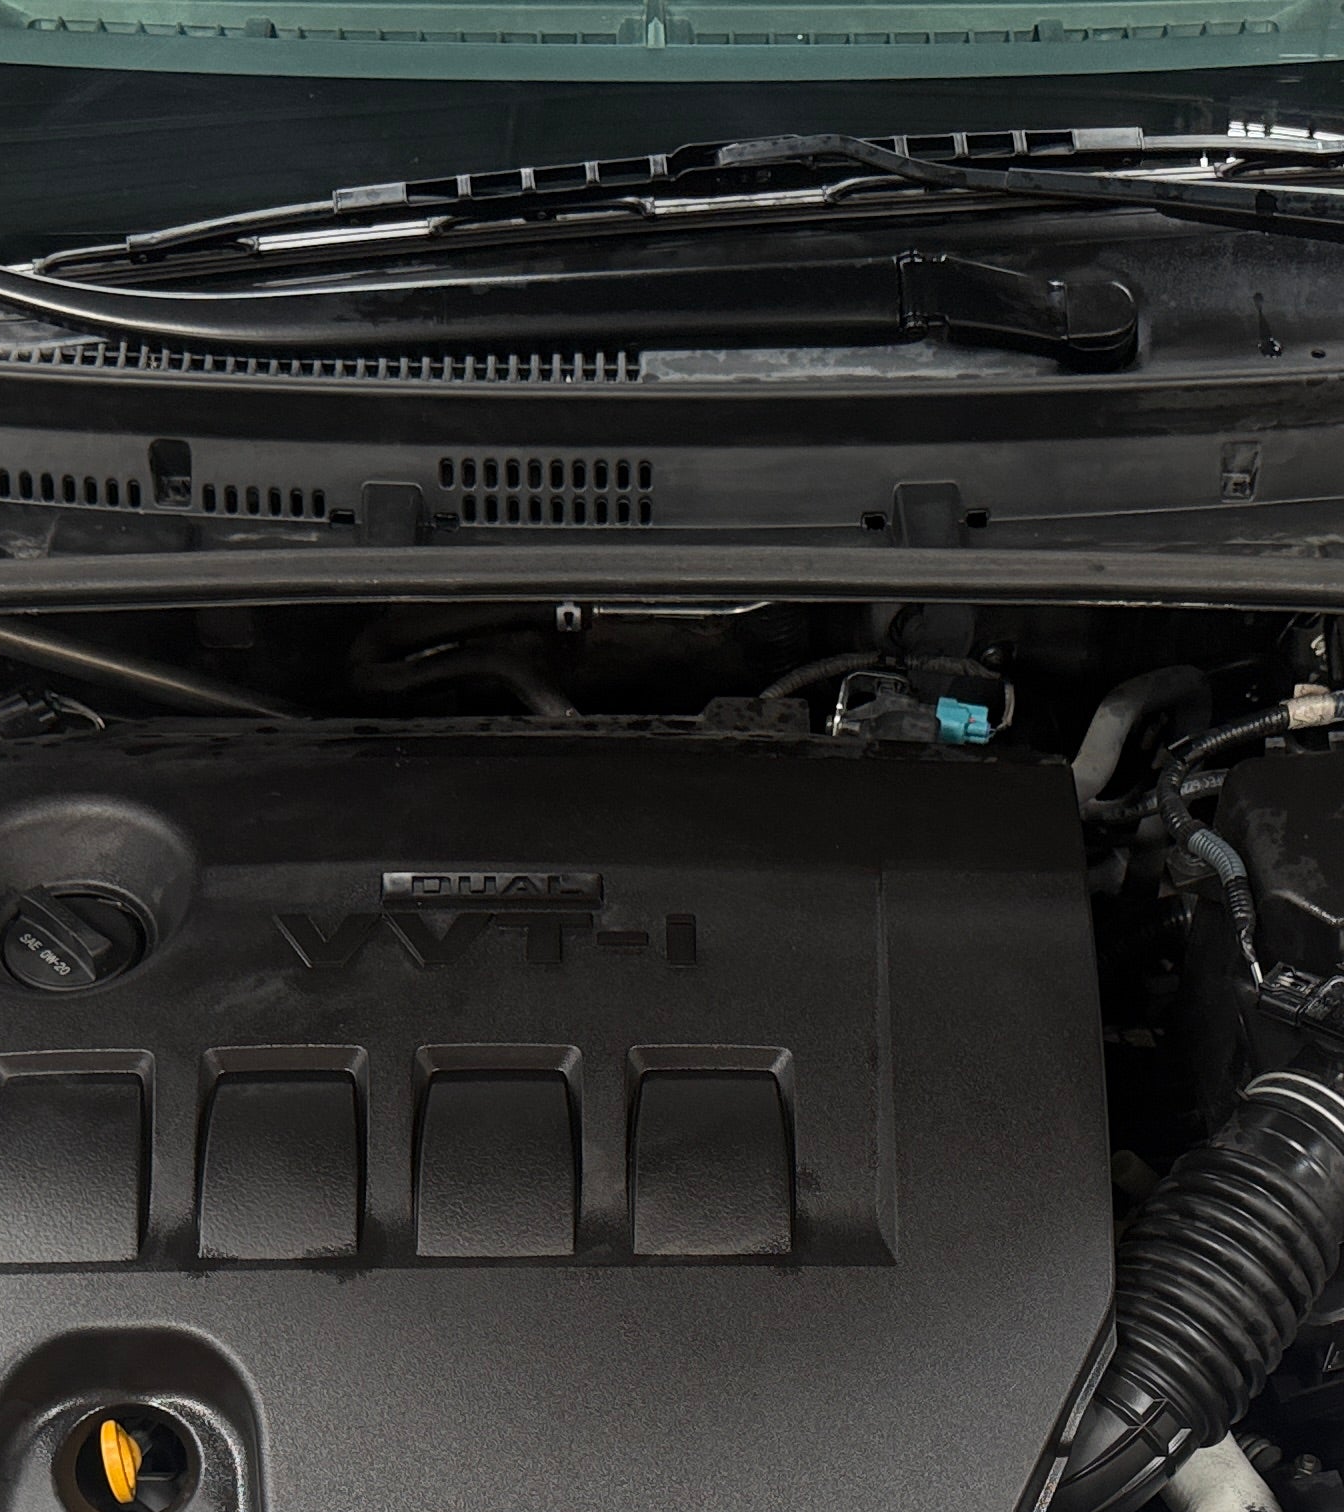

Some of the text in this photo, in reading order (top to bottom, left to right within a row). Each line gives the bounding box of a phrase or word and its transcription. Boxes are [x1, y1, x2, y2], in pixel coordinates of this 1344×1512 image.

[412, 876, 586, 898] DUAL
[19, 933, 71, 976] SAE 0W-20
